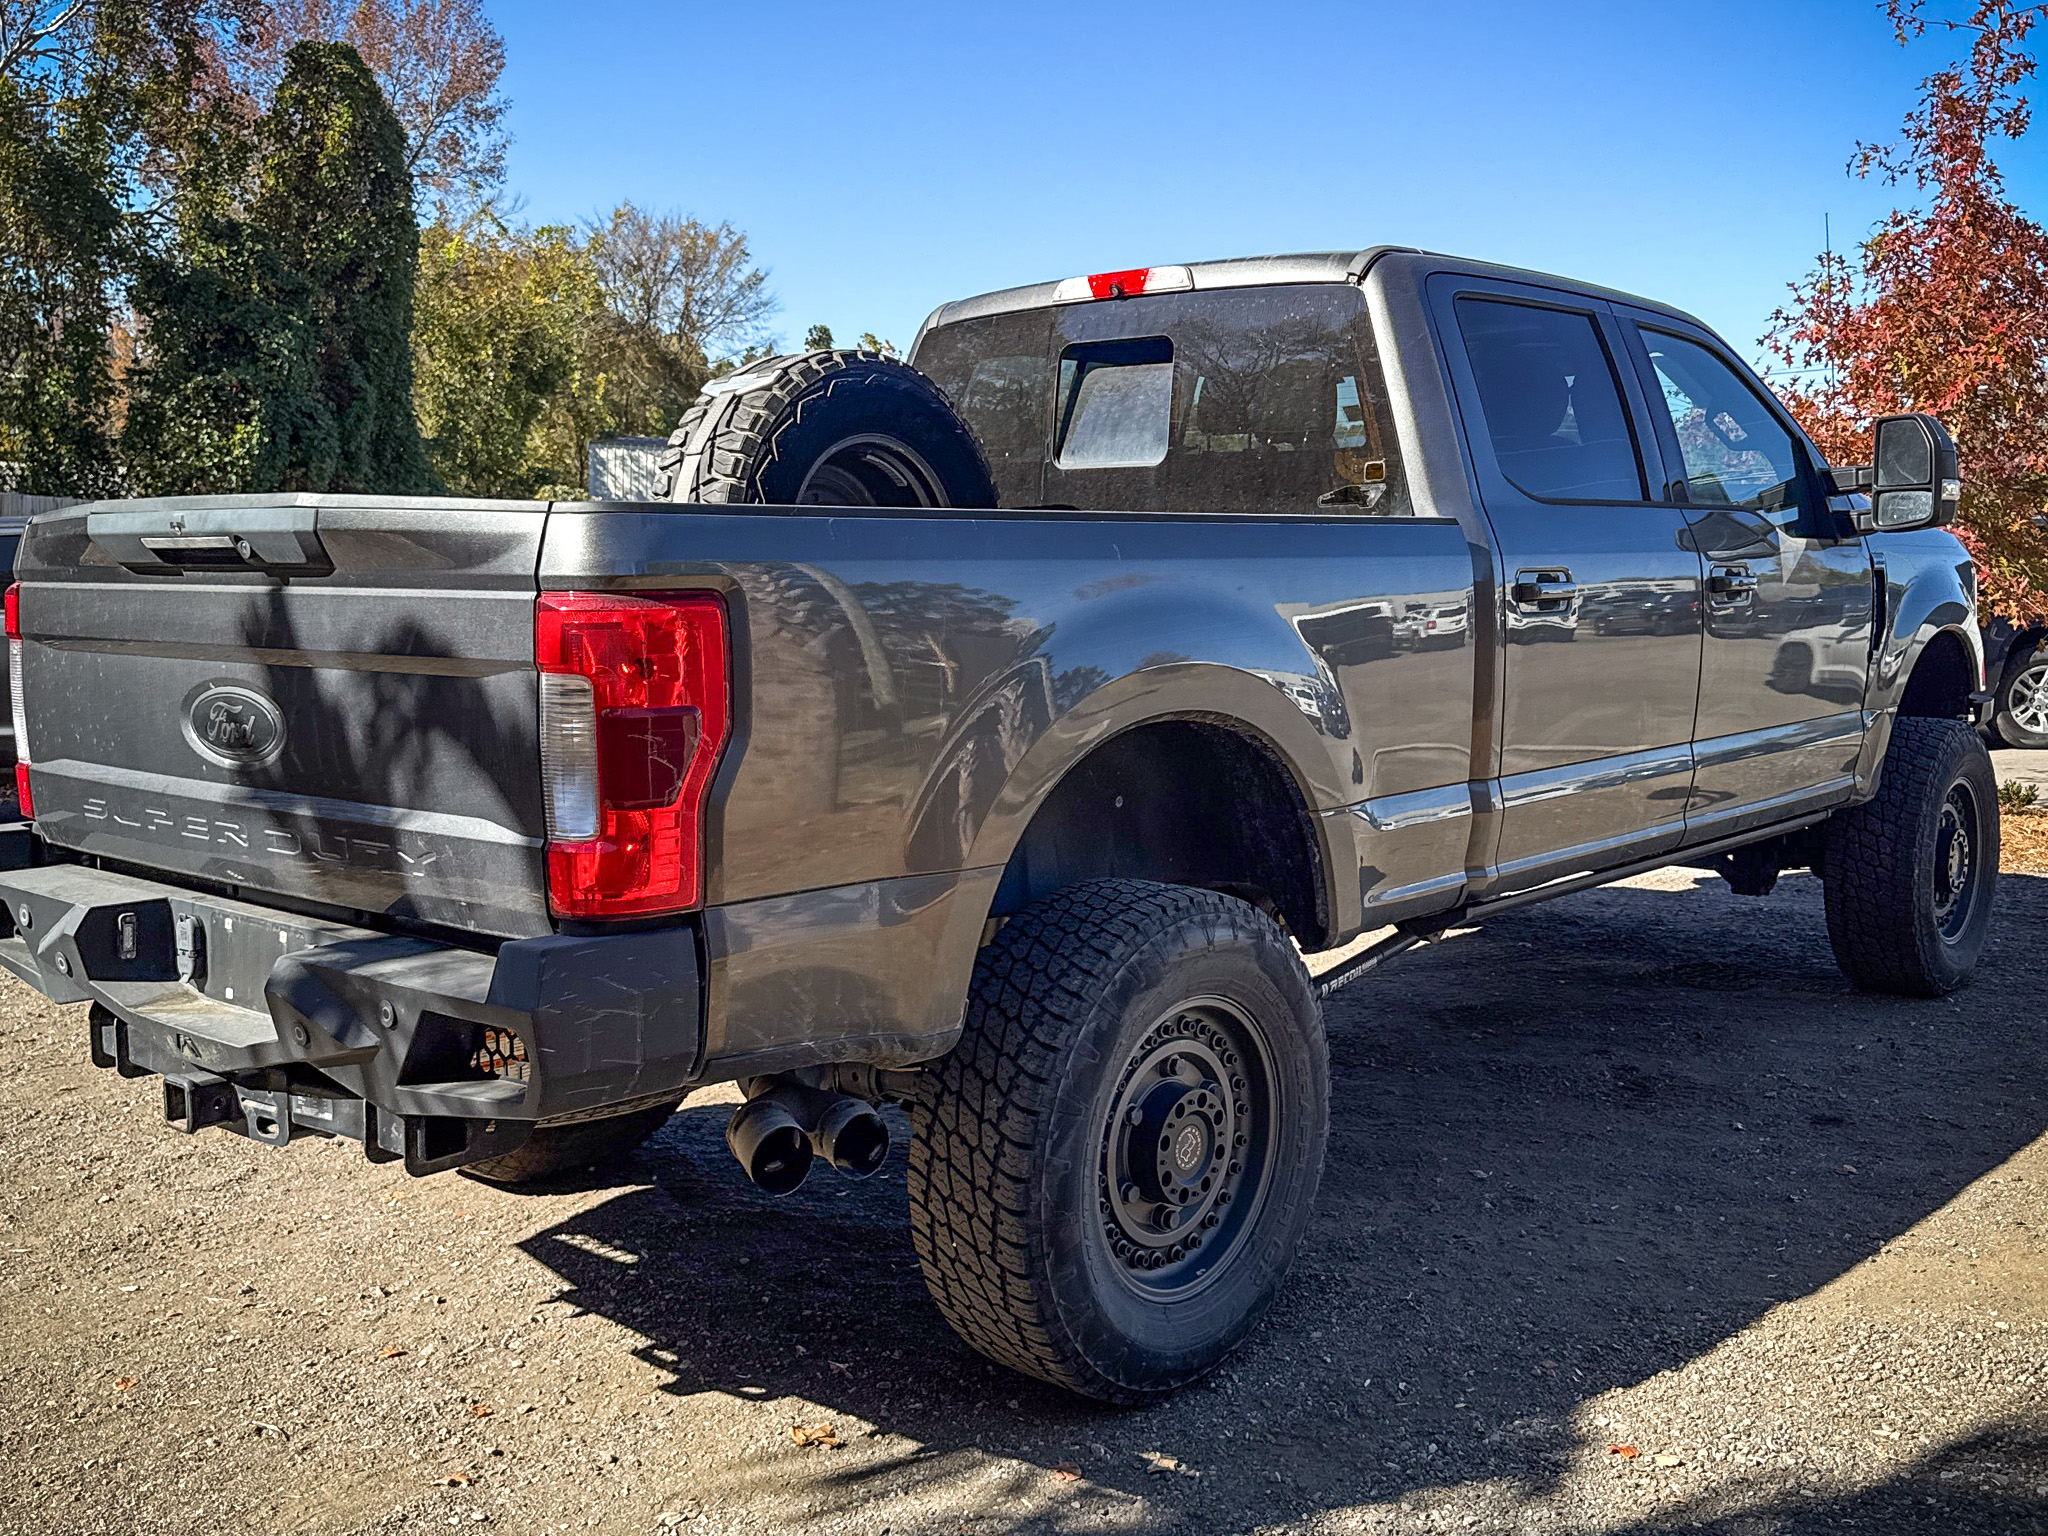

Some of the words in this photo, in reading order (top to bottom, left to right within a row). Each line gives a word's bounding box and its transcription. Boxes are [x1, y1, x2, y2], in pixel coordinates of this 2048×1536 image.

[206, 701, 256, 746] Ford
[83, 798, 249, 848] SUPER
[263, 829, 437, 877] DUTY
